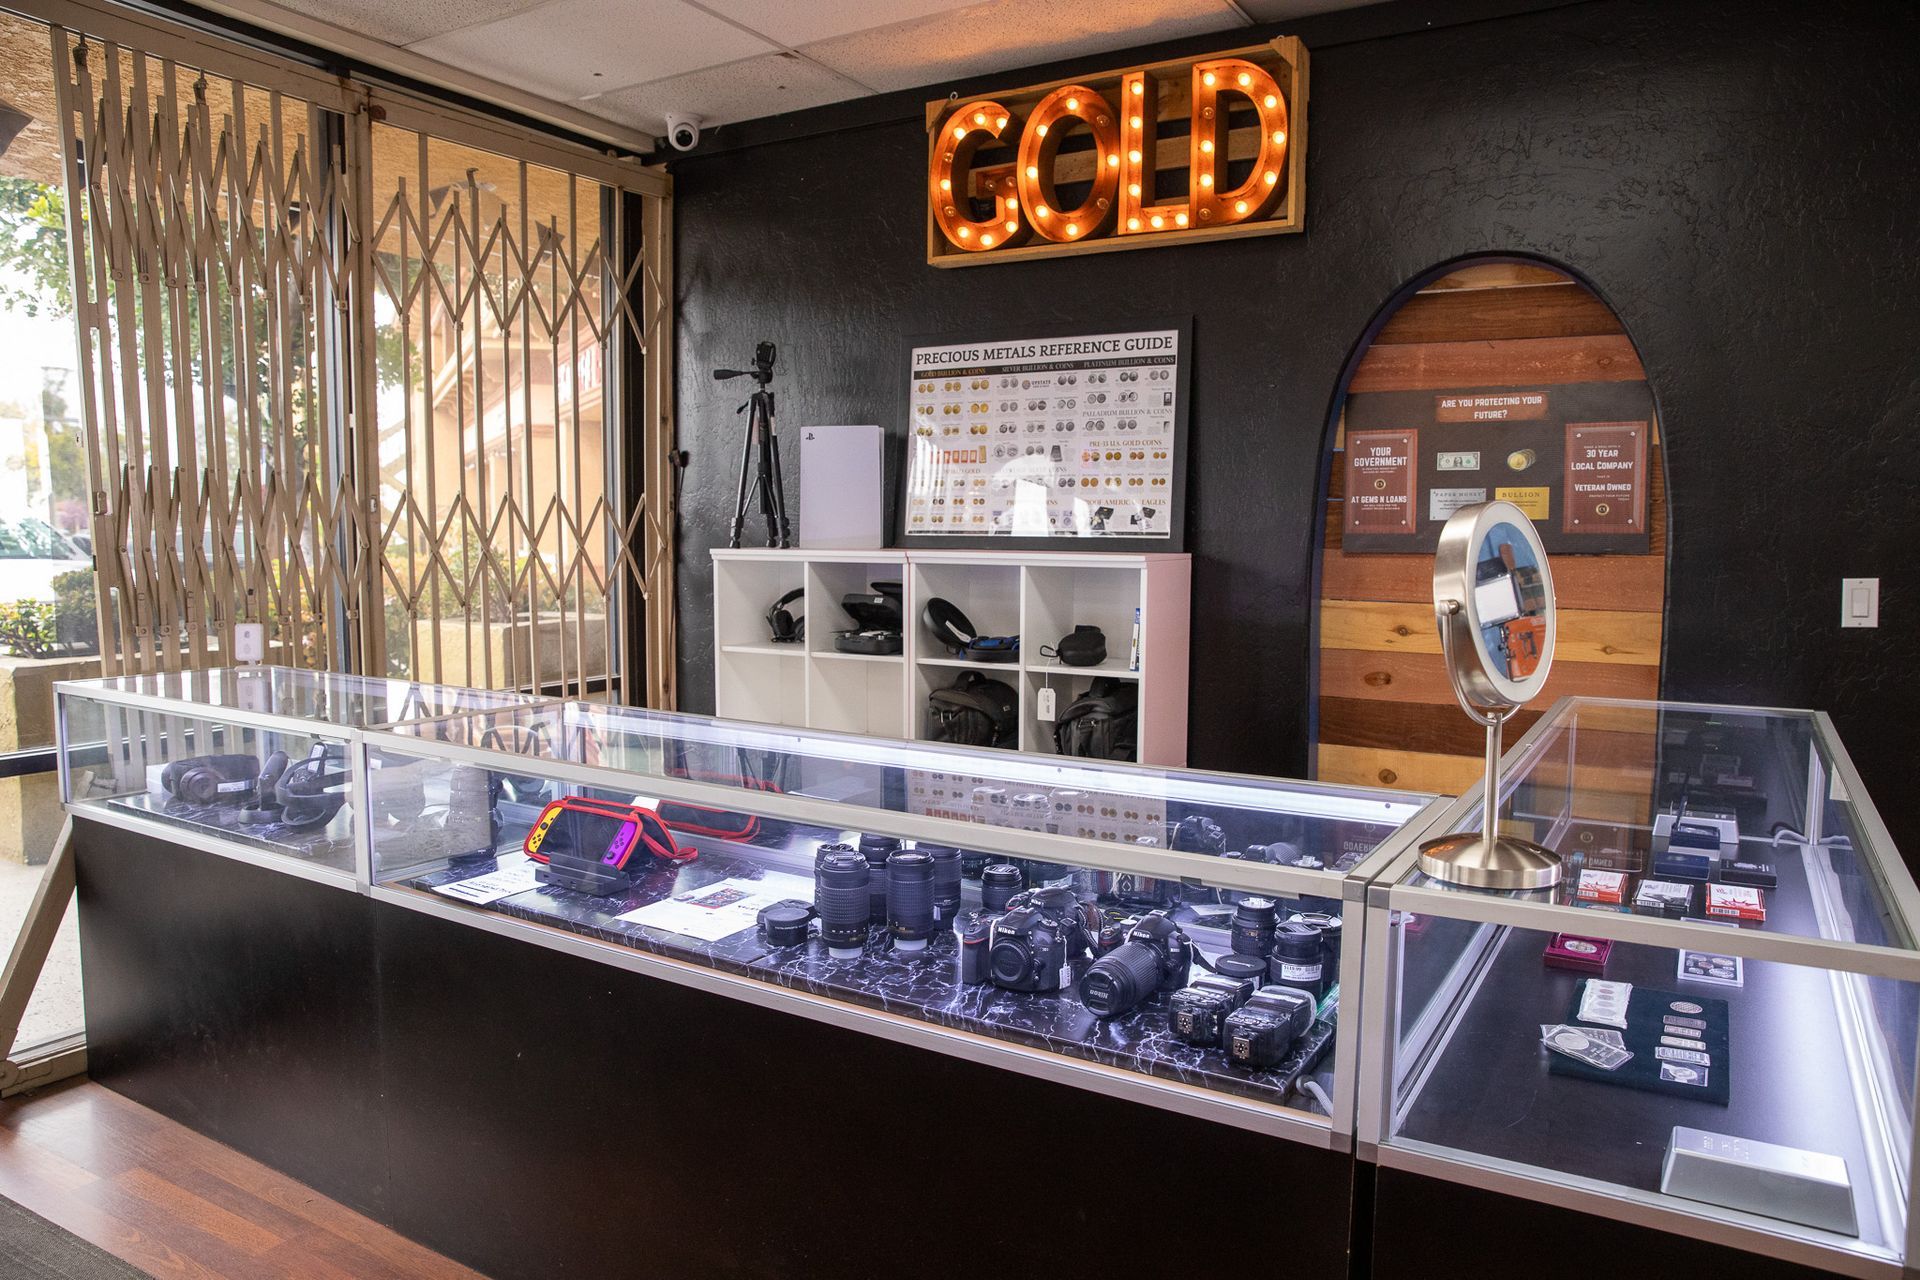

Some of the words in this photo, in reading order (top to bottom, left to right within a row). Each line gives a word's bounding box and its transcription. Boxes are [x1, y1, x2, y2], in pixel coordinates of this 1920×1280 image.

[930, 58, 1288, 251] GOLD
[916, 350, 980, 365] PRECIOUS
[983, 346, 1036, 360] METALS
[1040, 340, 1120, 356] REFERENCE
[1124, 336, 1172, 351] GUIDE
[1442, 399, 1456, 408] ARE
[1458, 398, 1473, 408] YOU
[1474, 397, 1520, 407] PROTECTING
[1522, 396, 1542, 405] YOUR
[1474, 410, 1508, 419] FUTURE?
[1370, 447, 1392, 456] YOUR
[1586, 450, 1596, 458] 30
[1598, 450, 1618, 458] YEAR
[1354, 456, 1407, 467] GOVERNMENT
[1571, 462, 1595, 470] LOCAL
[1597, 462, 1634, 470] COMPANY
[998, 927, 1015, 935] Nikon
[1133, 930, 1150, 939] Nikon
[1090, 989, 1108, 999] Nikon
